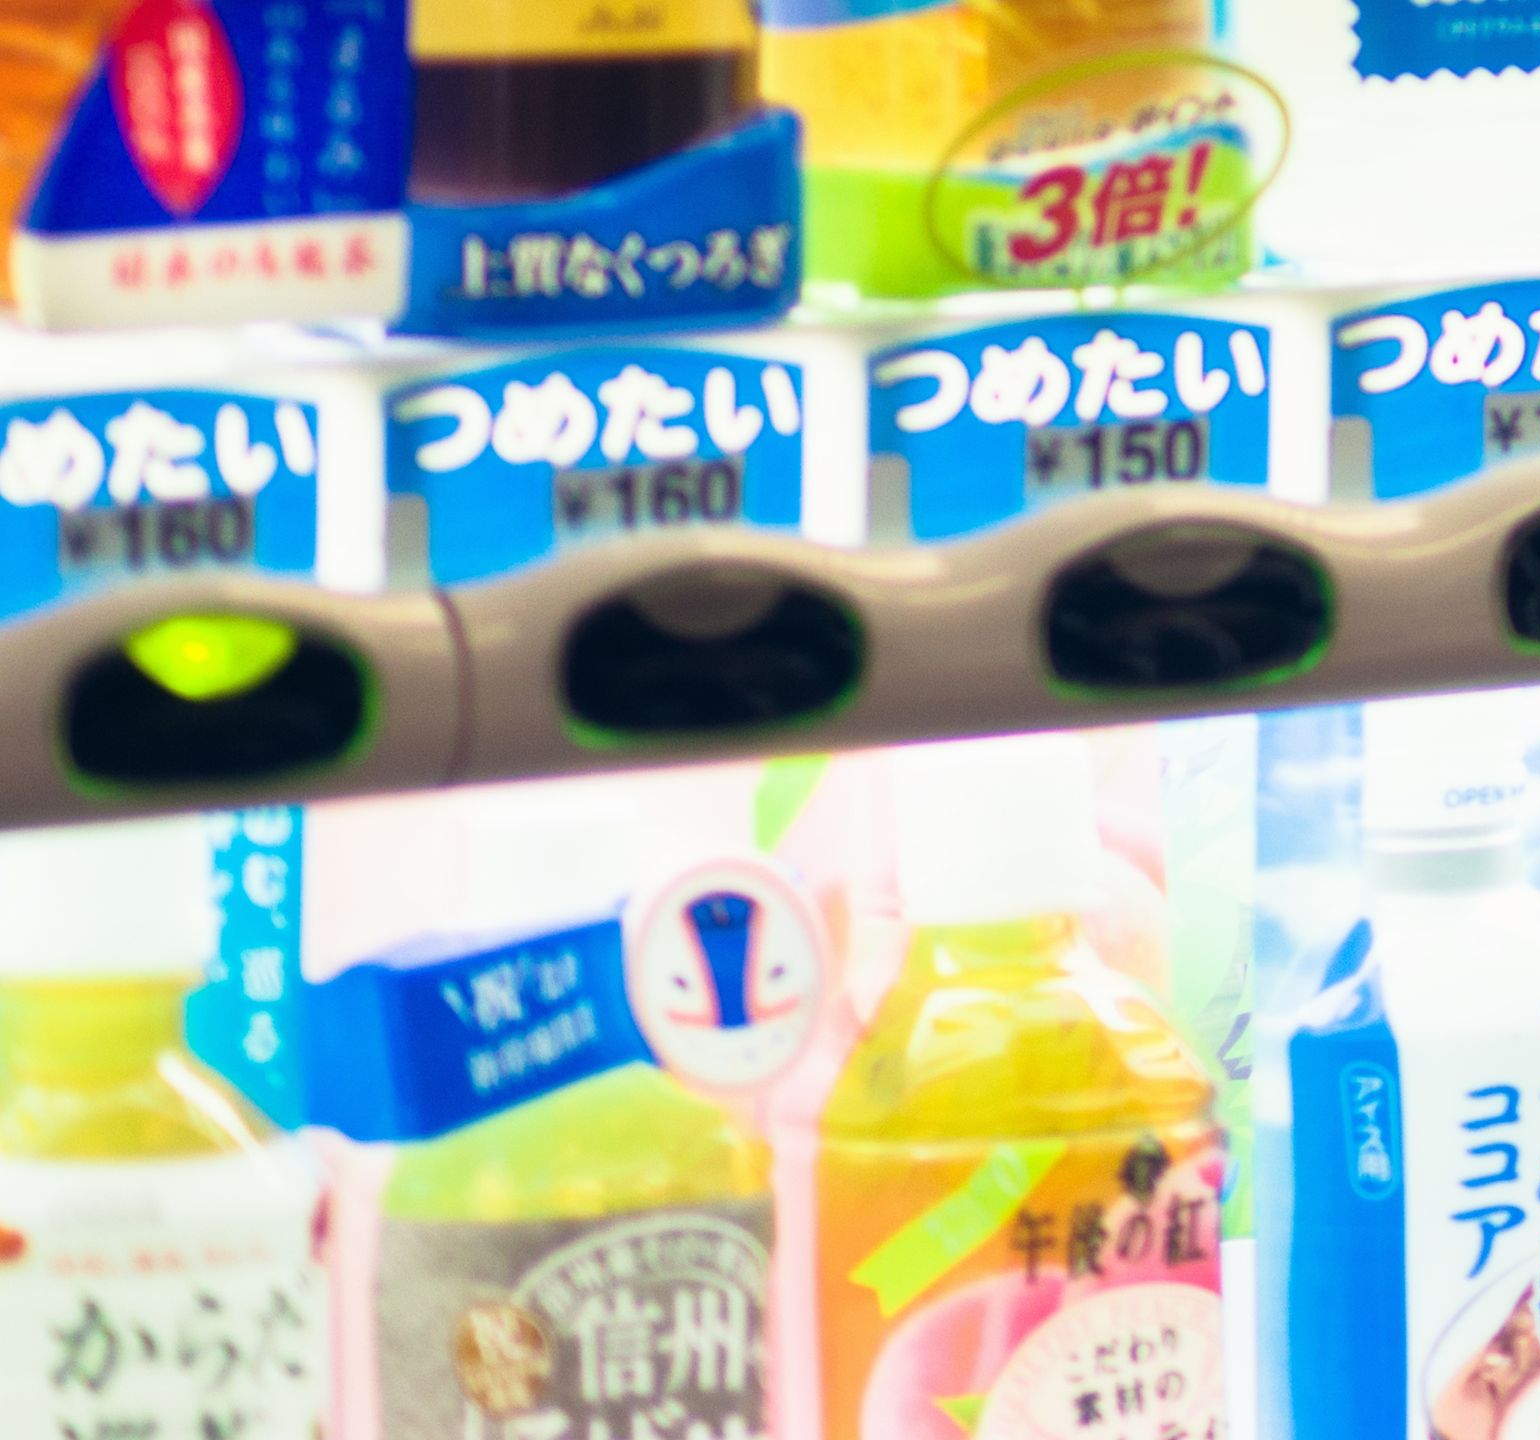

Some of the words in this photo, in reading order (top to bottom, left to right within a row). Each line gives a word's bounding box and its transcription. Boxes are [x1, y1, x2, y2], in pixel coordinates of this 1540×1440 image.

[1005, 140, 1213, 268] 3倍!
[394, 365, 800, 472] つめたい
[877, 328, 1266, 431] つめたい
[1029, 422, 1201, 492] ¥150
[1450, 1082, 1529, 1282] ココア
